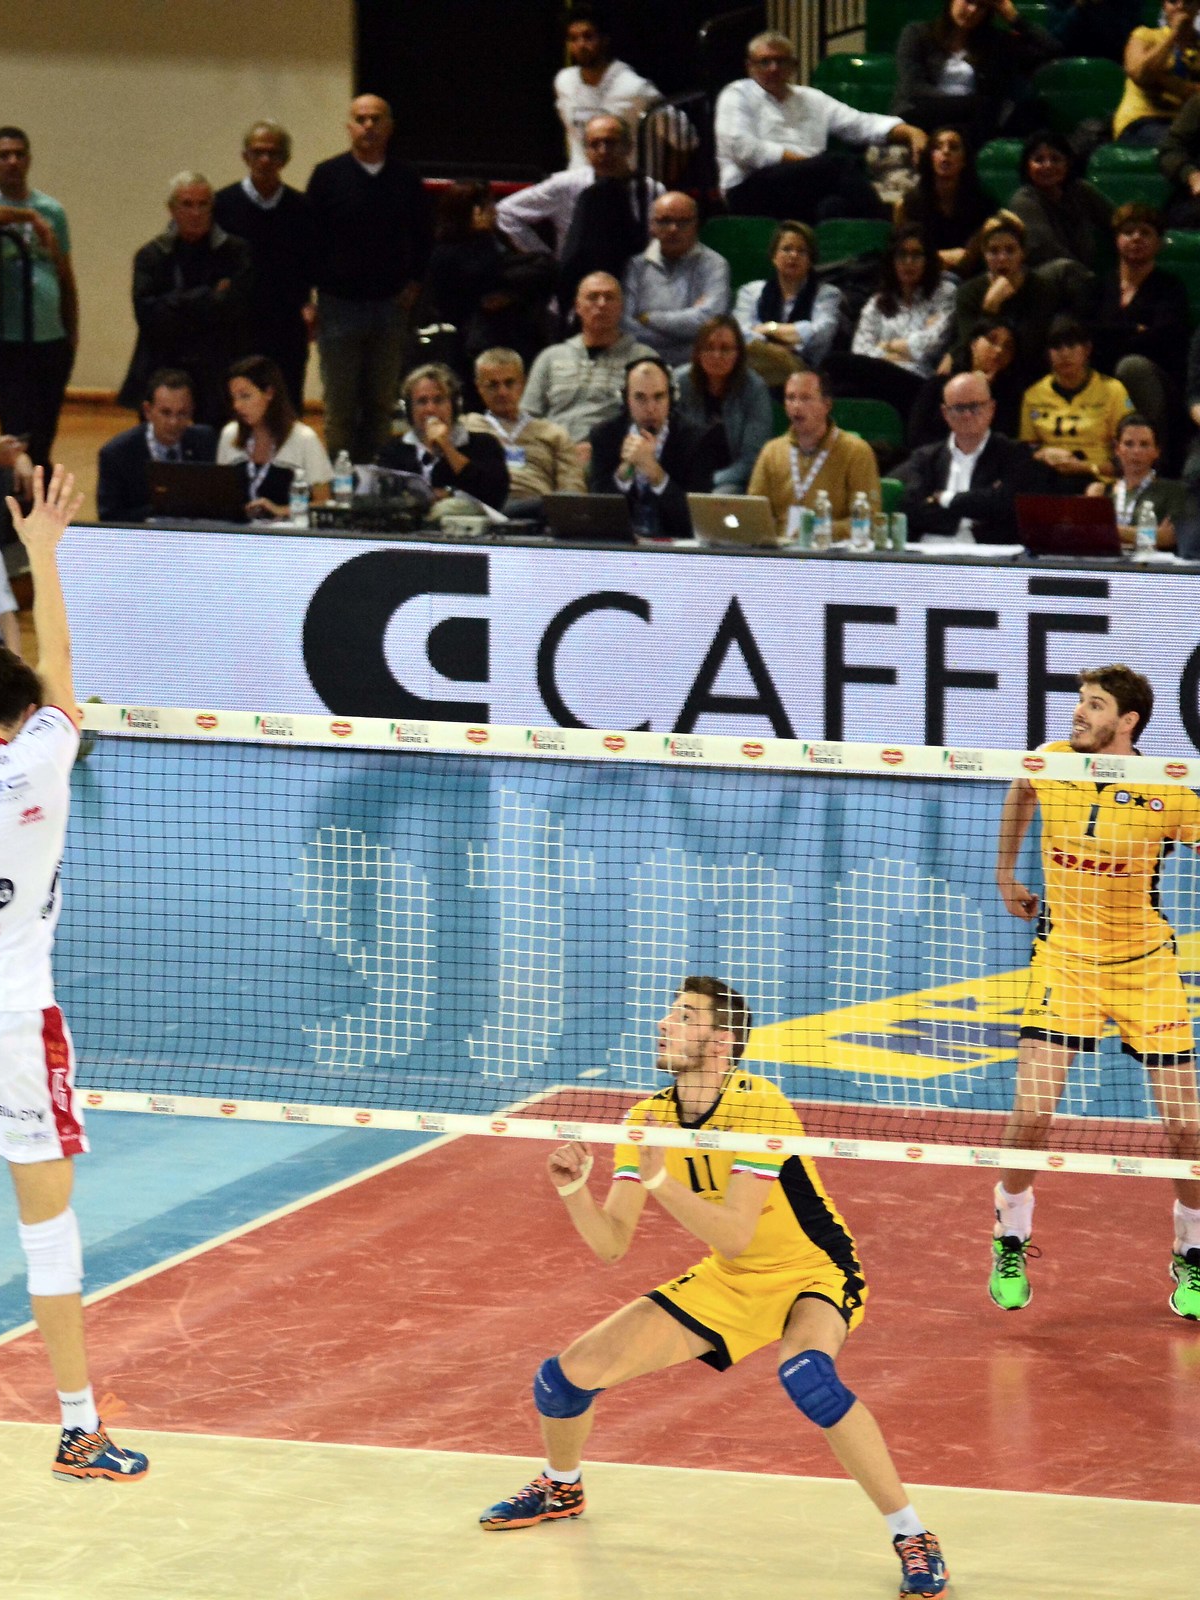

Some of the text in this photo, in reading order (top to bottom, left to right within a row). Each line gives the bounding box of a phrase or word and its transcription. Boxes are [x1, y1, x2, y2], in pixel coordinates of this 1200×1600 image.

[1084, 803, 1101, 837] 1
[1052, 846, 1131, 878] DHL
[683, 1154, 719, 1194] 11
